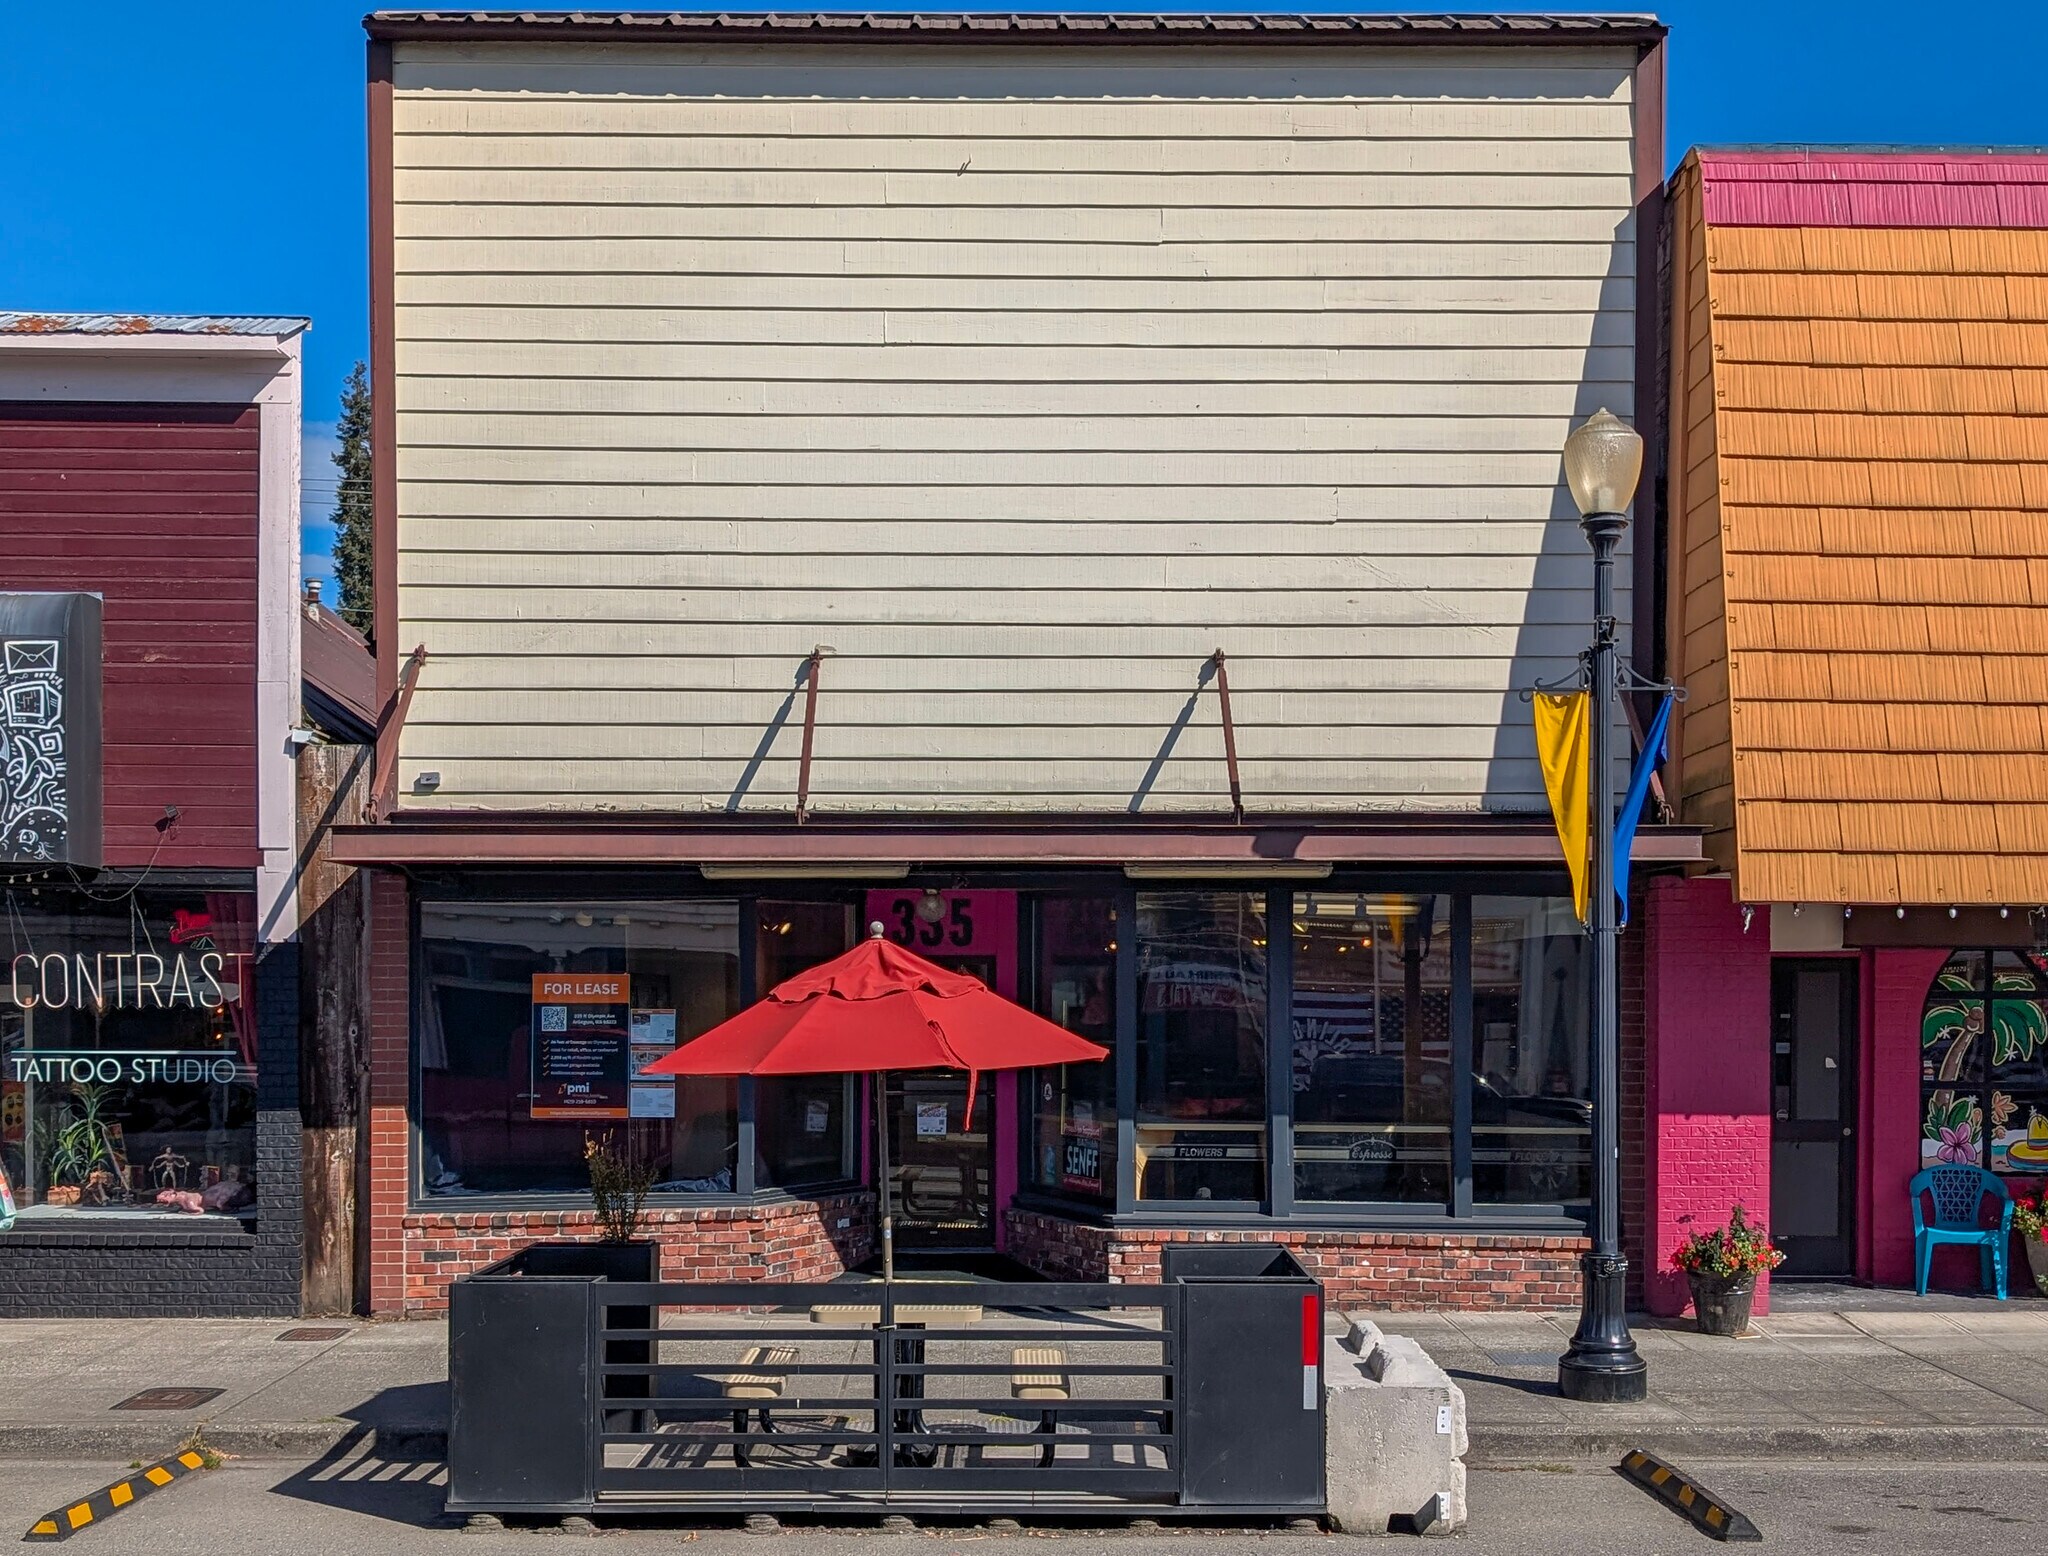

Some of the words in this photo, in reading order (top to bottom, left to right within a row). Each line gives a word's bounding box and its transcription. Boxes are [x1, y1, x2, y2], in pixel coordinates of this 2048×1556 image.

[12, 953, 253, 1009] CONTRAST
[544, 983, 572, 995] FOR
[576, 983, 619, 995] LEASE
[11, 1058, 121, 1083] TATTOO
[131, 1058, 236, 1083] STUDIO
[567, 1082, 590, 1095] pmi
[1180, 1147, 1223, 1157] FLOWERS
[1352, 1146, 1393, 1161] Espresso
[1066, 1145, 1098, 1178] SENFF
